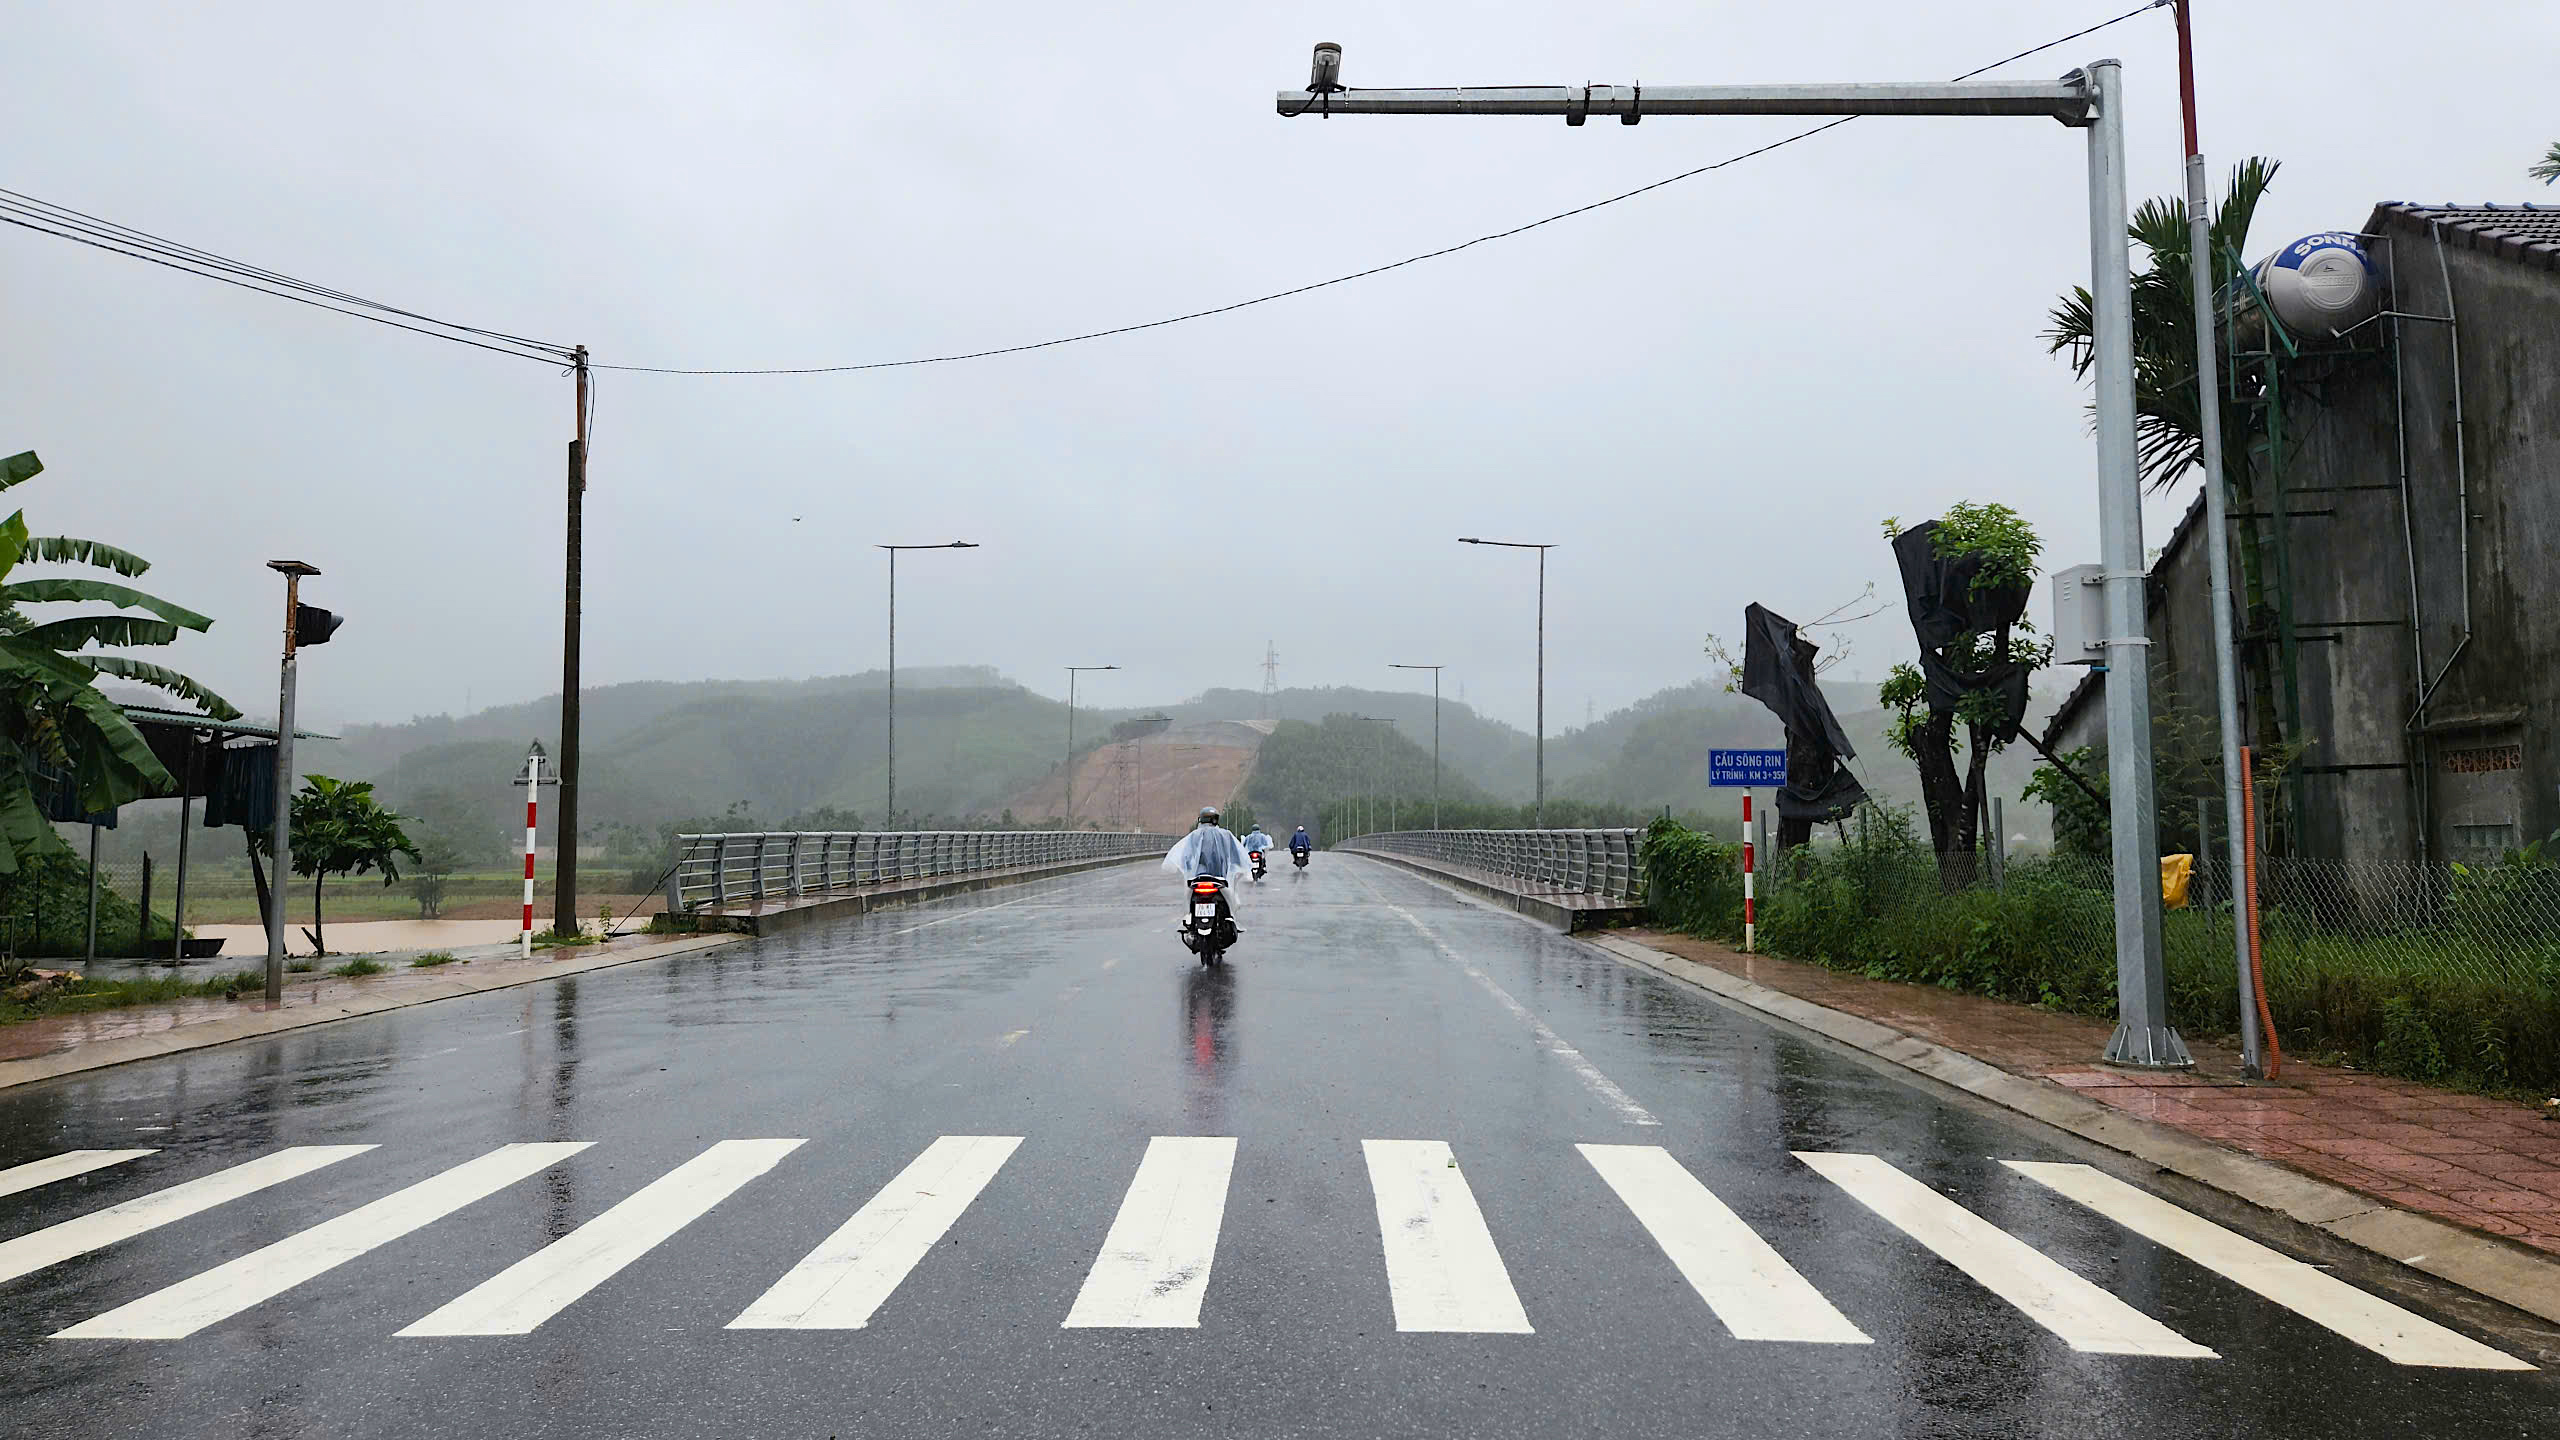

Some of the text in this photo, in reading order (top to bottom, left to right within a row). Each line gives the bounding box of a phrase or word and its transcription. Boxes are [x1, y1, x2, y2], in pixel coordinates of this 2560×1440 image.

[1736, 753, 1762, 767] SÔNG
[1765, 755, 1782, 767] RIN
[1749, 771, 1761, 780] KM
